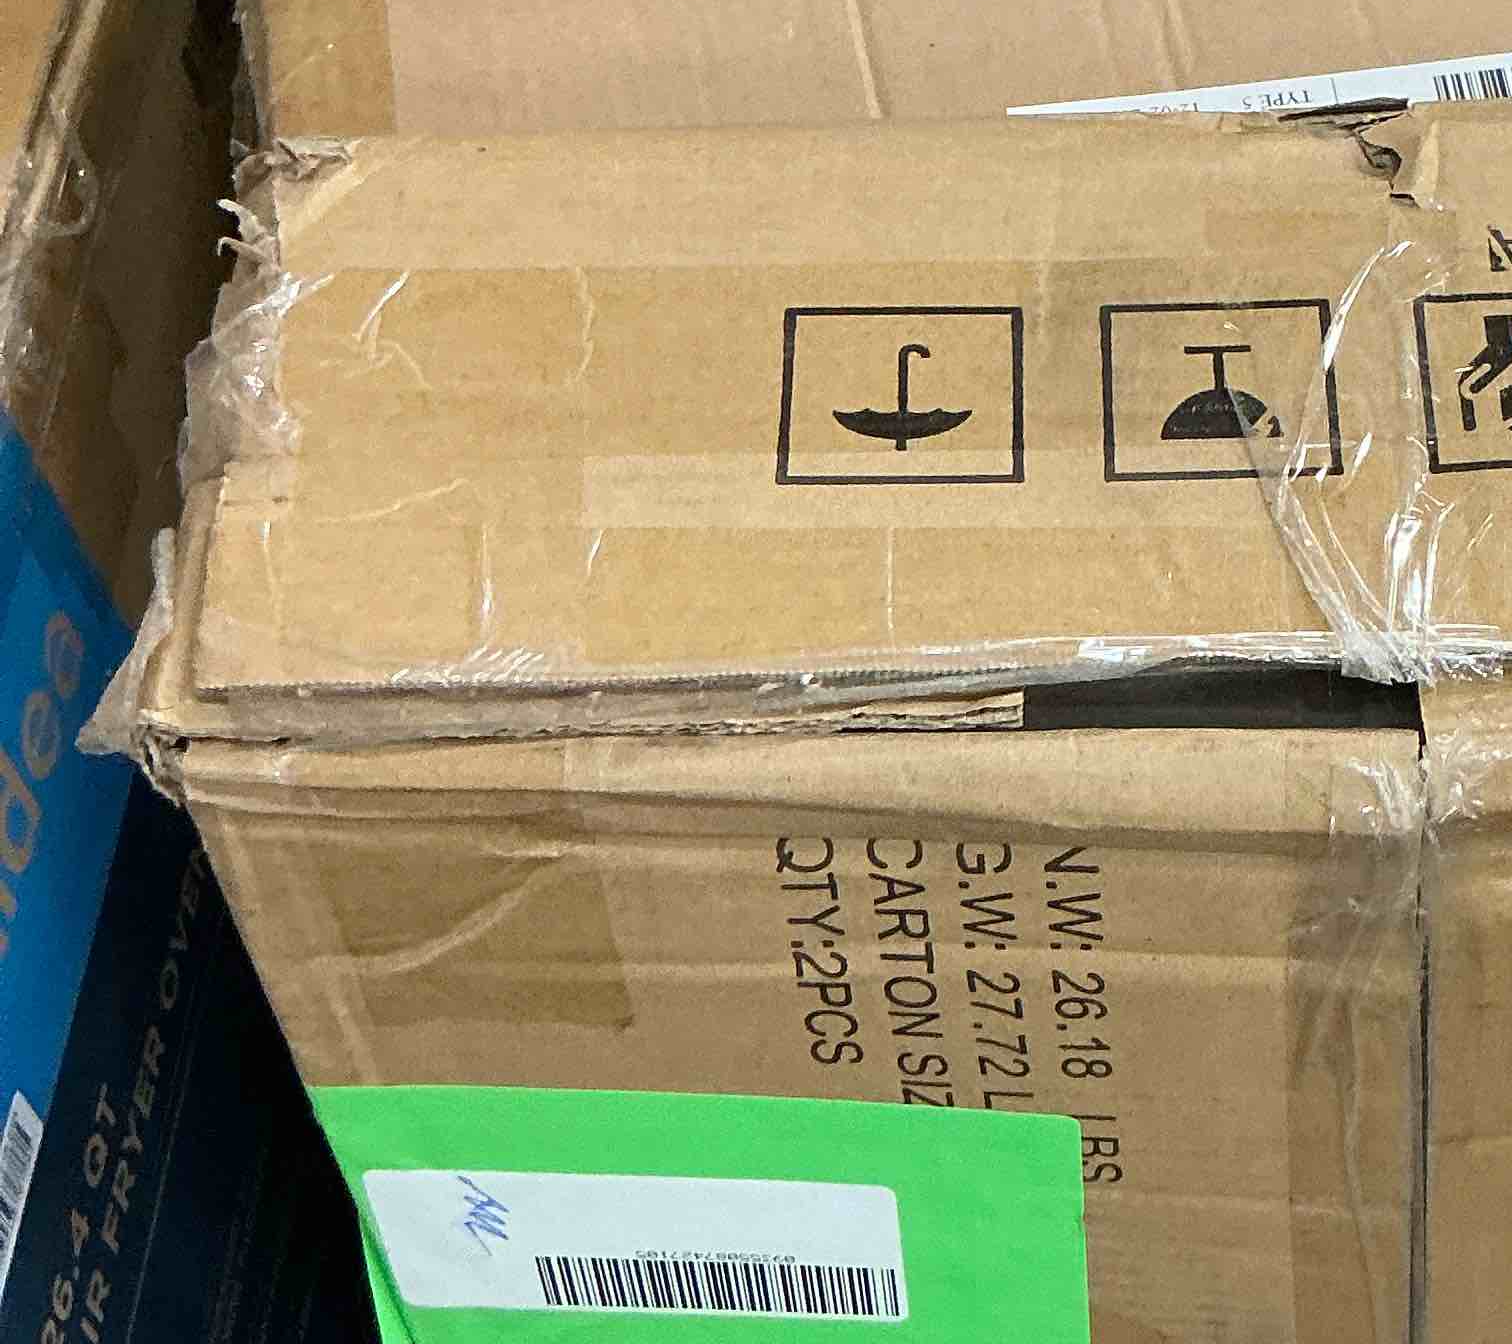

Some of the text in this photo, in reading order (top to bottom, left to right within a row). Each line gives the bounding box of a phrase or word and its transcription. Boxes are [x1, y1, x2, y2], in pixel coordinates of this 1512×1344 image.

[775, 837, 865, 1066] QTY:2PCS
[866, 838, 944, 1039] CARTON
[966, 969, 1031, 1078] 27.72
[1051, 969, 1114, 1079] 26.18
